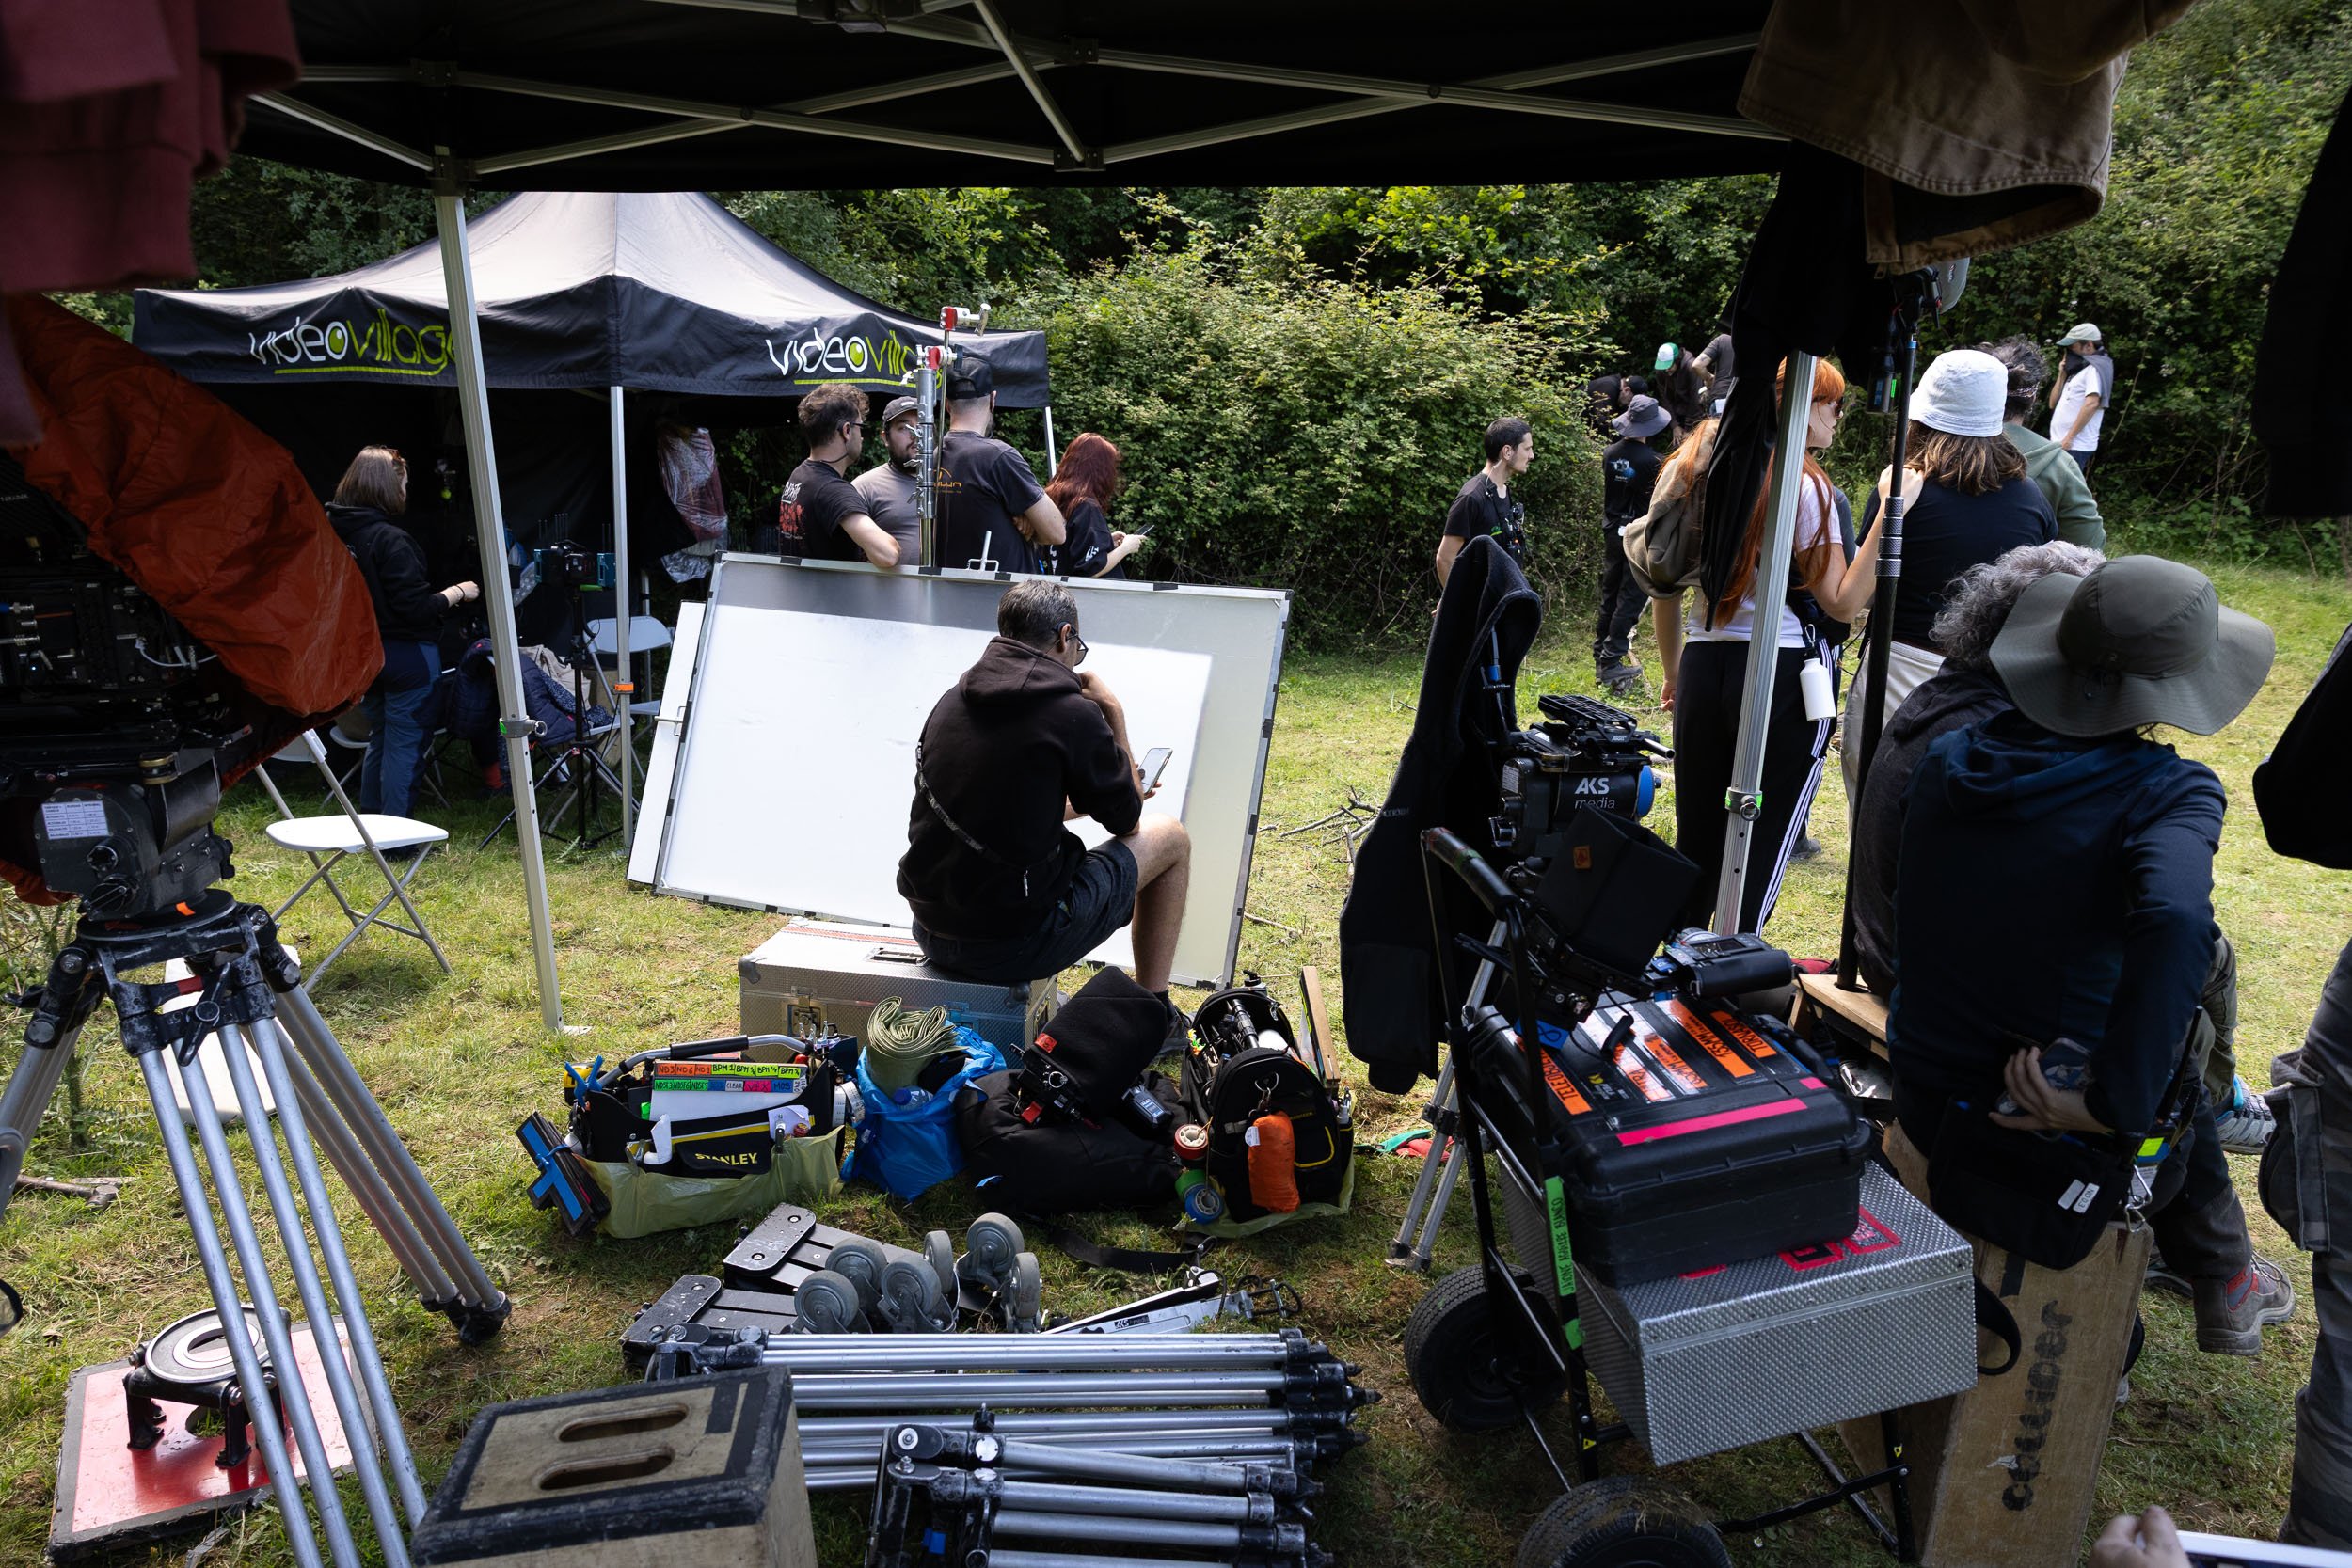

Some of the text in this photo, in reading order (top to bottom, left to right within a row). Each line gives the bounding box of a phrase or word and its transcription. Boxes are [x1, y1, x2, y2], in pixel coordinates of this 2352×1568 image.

[1574, 777, 1610, 795] AKS
[712, 1064, 728, 1072] BPM
[736, 1065, 749, 1073] BPM
[726, 1082, 743, 1090] CLEAR
